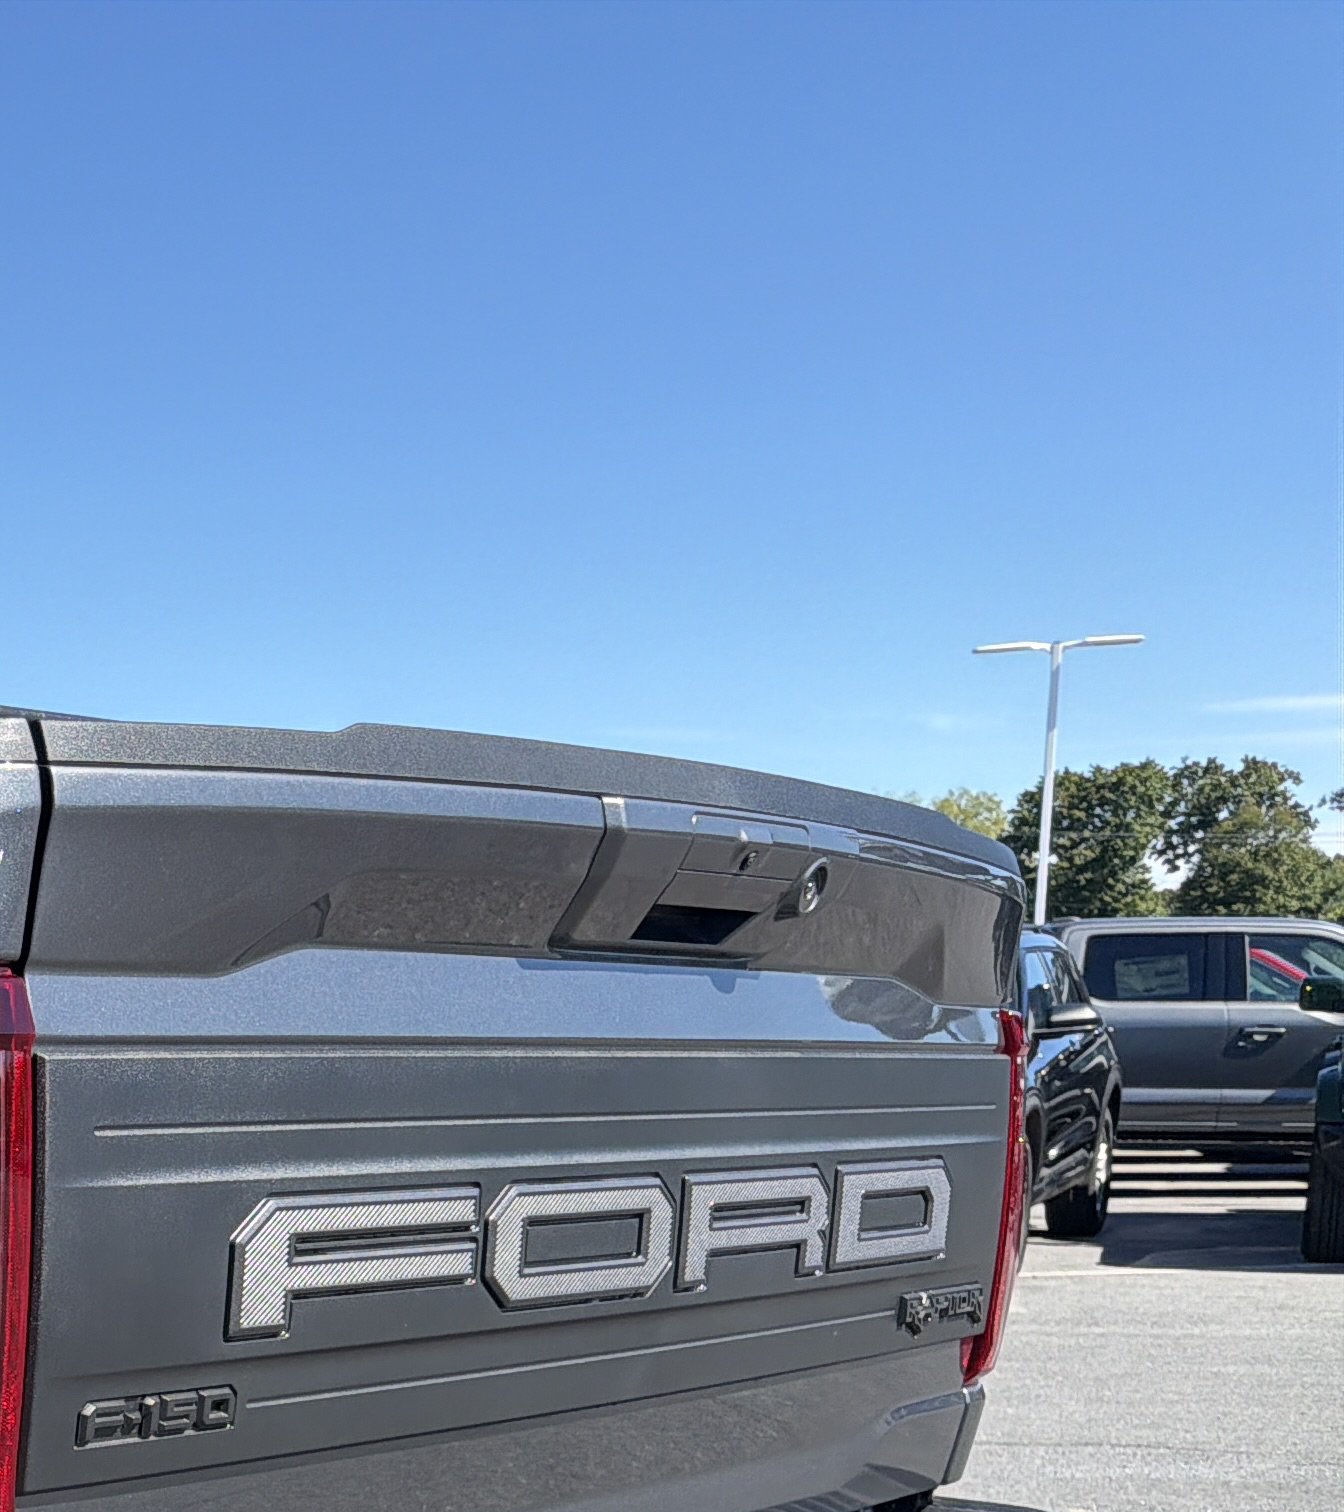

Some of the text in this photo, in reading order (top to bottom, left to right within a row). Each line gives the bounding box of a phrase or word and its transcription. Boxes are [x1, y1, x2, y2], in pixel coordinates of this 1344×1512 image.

[223, 1156, 953, 1342] FORD
[896, 1281, 984, 1336] RAPTOR
[73, 1383, 238, 1450] F-150
